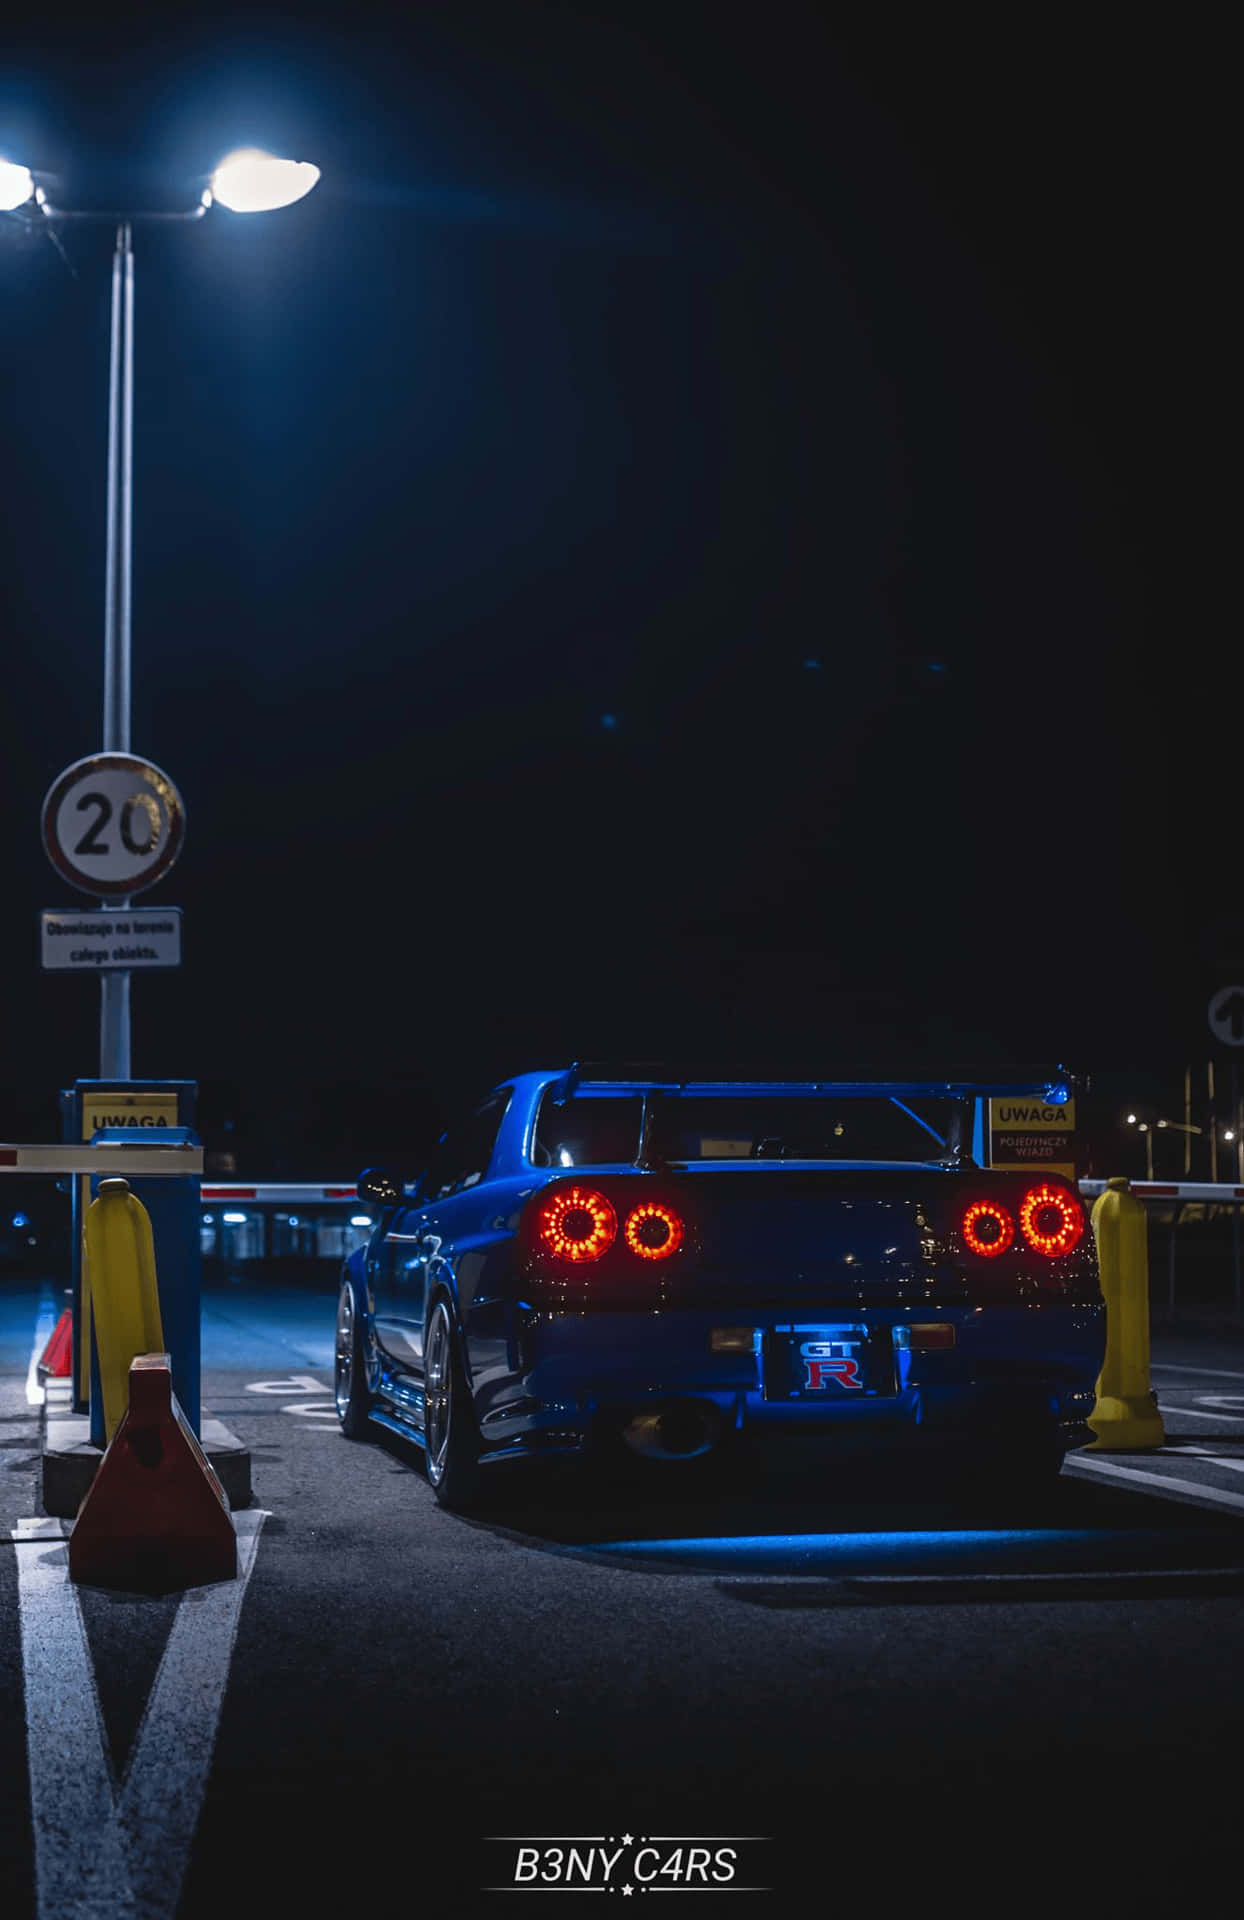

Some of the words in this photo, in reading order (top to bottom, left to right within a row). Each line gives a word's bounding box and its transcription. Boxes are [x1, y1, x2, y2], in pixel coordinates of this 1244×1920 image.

[75, 792, 161, 855] 20
[93, 1115, 167, 1128] UWAGA
[999, 1107, 1066, 1122] UWAGA
[800, 1341, 862, 1357] GT
[801, 1357, 863, 1390] R
